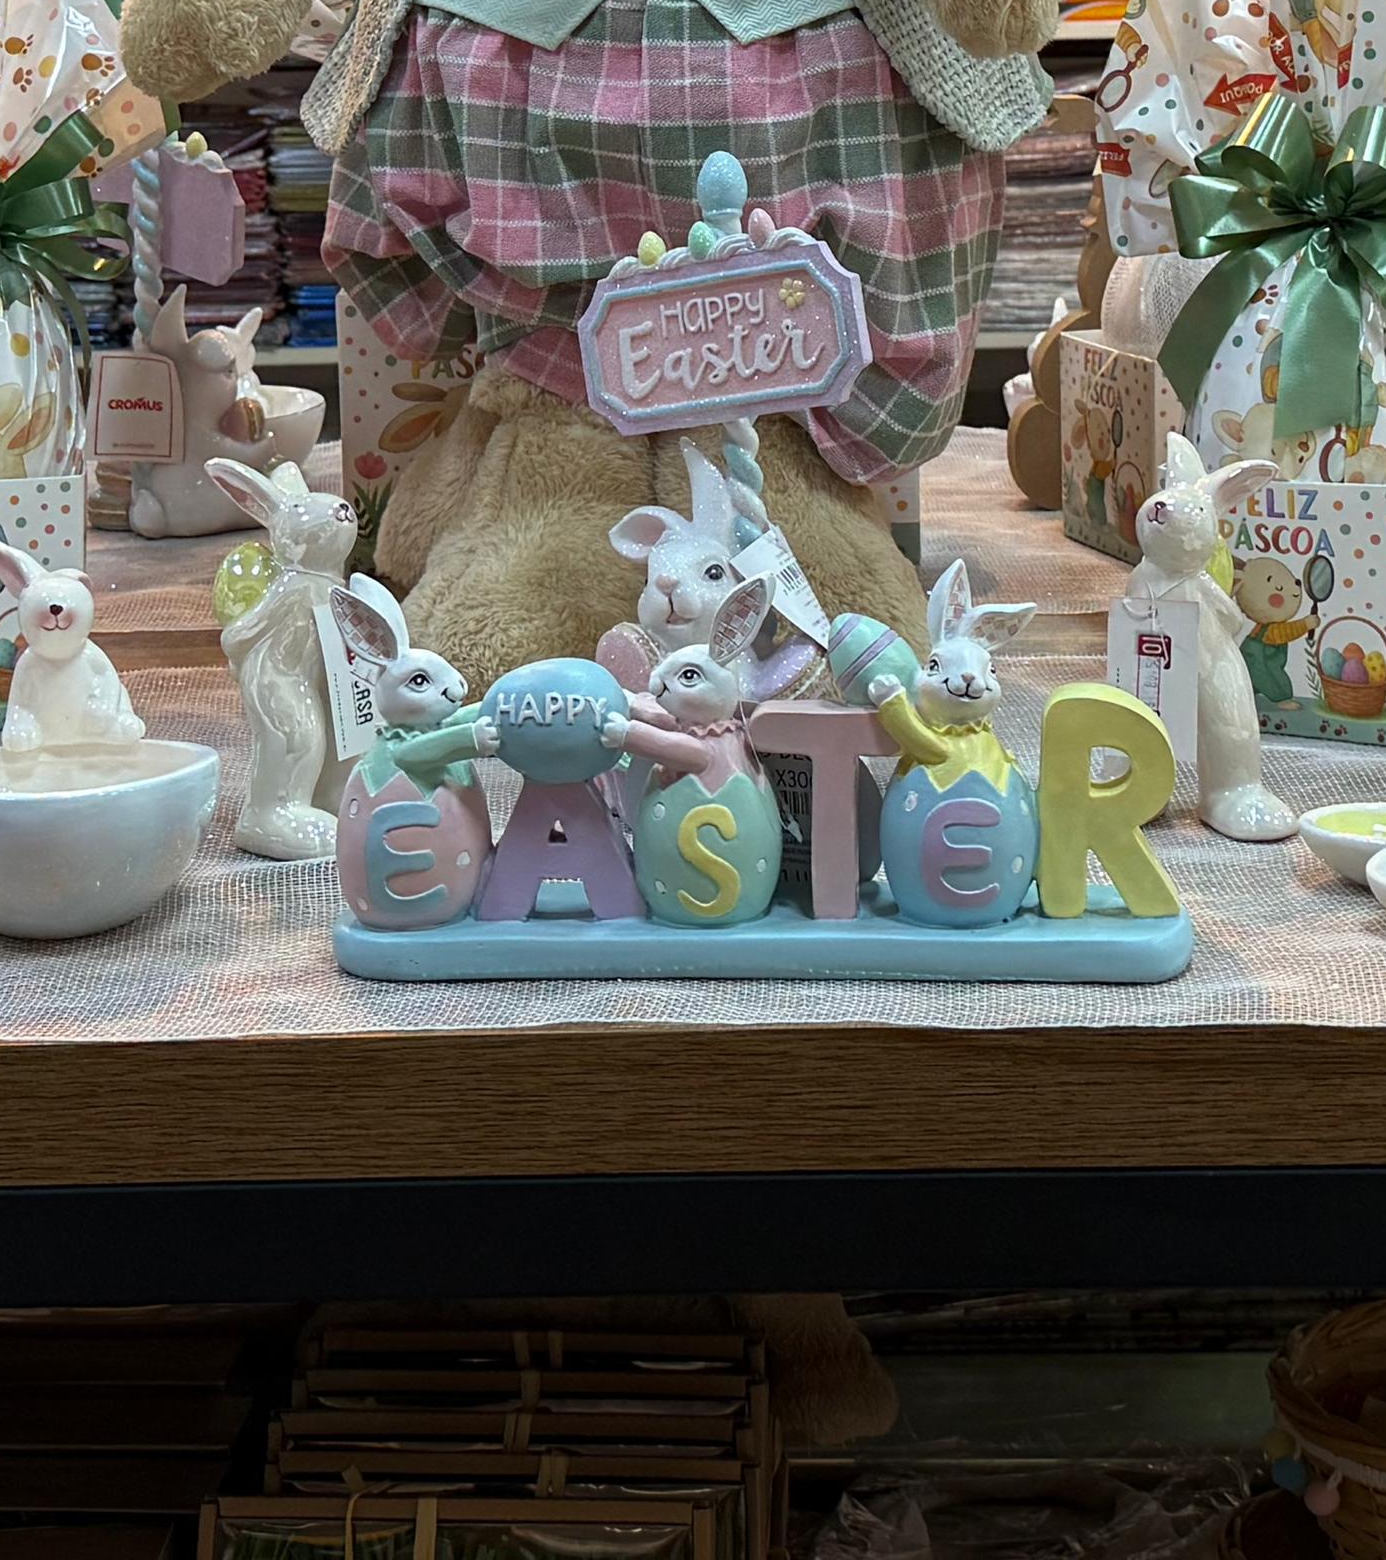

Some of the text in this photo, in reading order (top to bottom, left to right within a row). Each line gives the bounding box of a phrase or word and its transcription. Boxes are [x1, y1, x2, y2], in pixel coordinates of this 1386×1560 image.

[617, 318, 826, 400] Easter
[108, 396, 164, 412] CROMUS
[1228, 487, 1318, 521] ELIZ
[1218, 517, 1336, 558] PÁSCOA
[494, 690, 608, 728] HAPPY
[775, 768, 813, 789] X30
[365, 681, 1181, 923] EASTER
